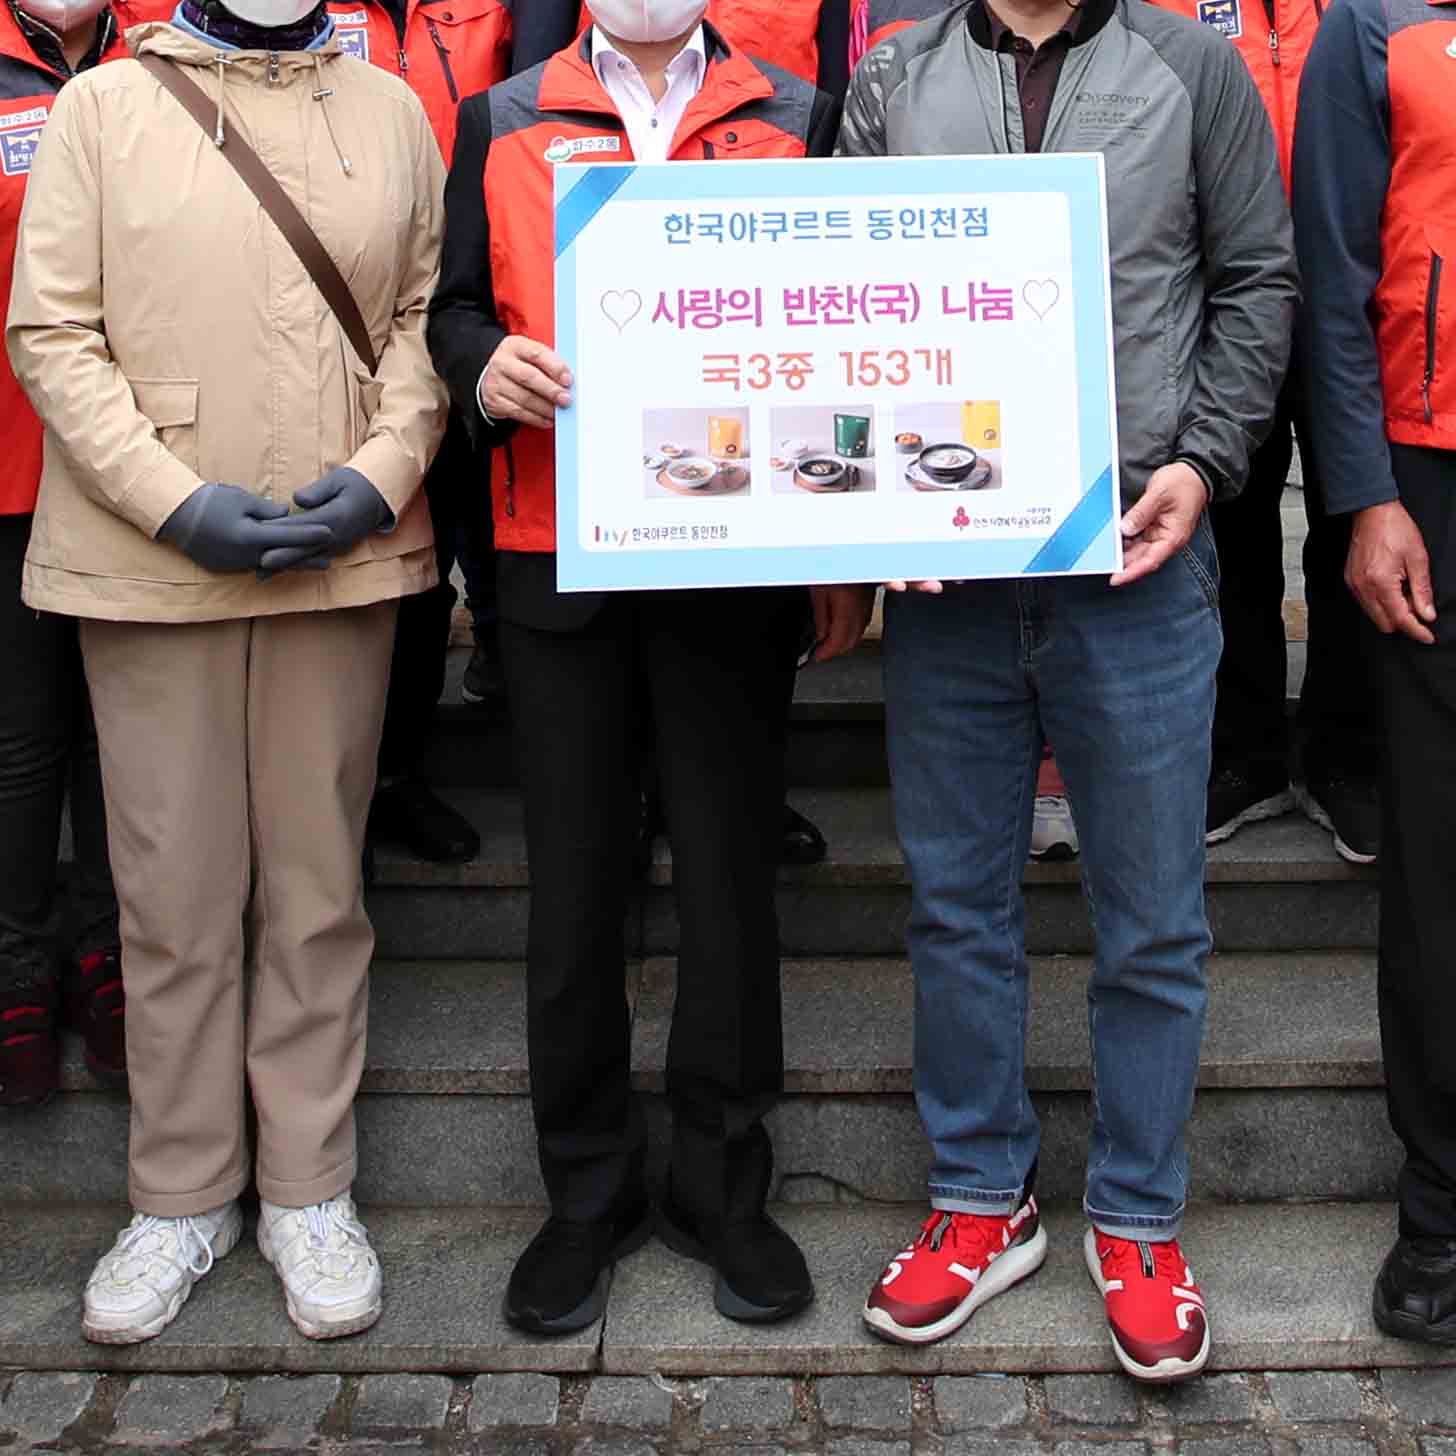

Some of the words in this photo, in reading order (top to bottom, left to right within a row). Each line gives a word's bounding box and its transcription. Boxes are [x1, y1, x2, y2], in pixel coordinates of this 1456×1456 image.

[663, 211, 853, 244] 한국야쿠르트
[867, 207, 990, 240] 동인천점
[651, 288, 763, 328] 사랑의
[782, 283, 921, 326] 반찬(국)
[941, 281, 1014, 322] 나눔
[701, 352, 815, 390] 국3종
[839, 348, 953, 388] 153개
